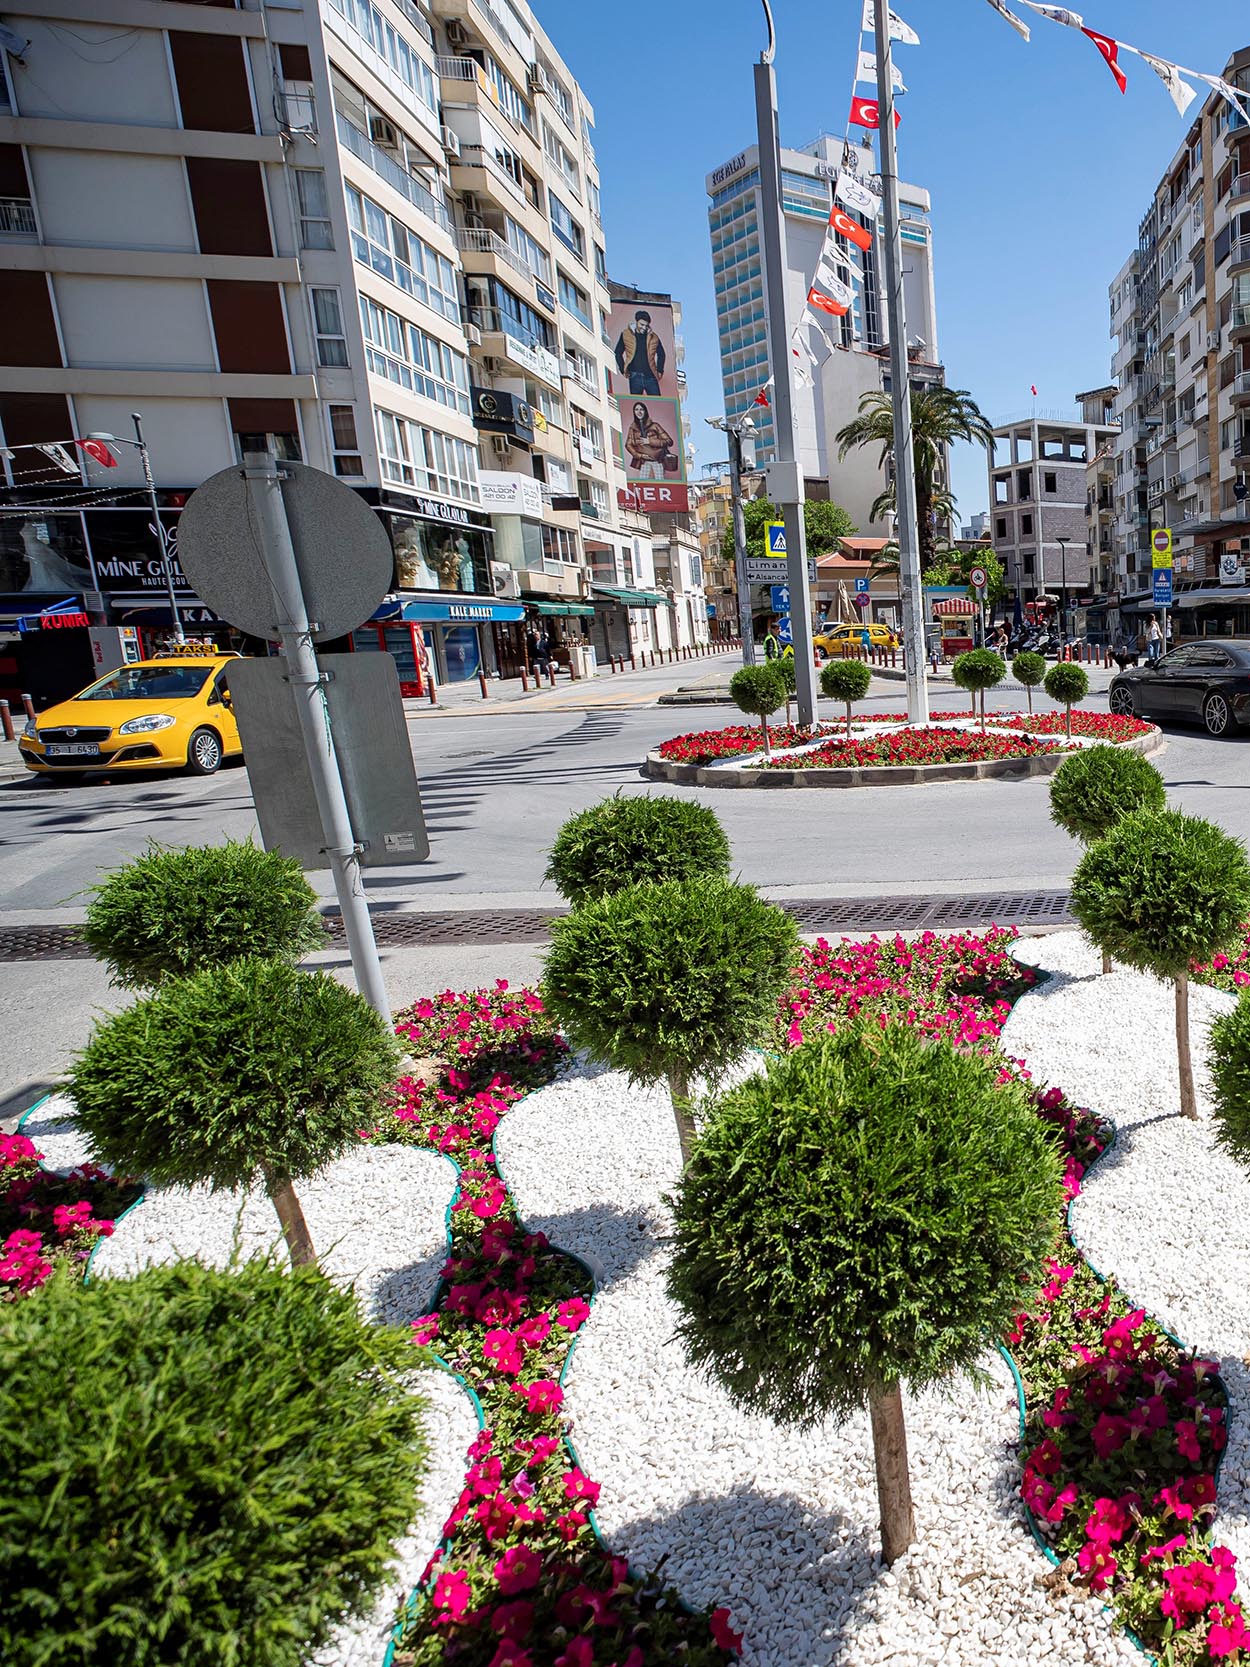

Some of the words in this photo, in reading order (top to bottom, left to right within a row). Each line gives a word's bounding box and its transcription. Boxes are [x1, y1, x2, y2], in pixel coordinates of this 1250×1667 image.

[748, 561, 787, 569] Liman
[141, 577, 168, 586] HAUTE
[857, 580, 866, 591] P
[449, 605, 467, 616] KALE
[469, 606, 493, 617] MARKET
